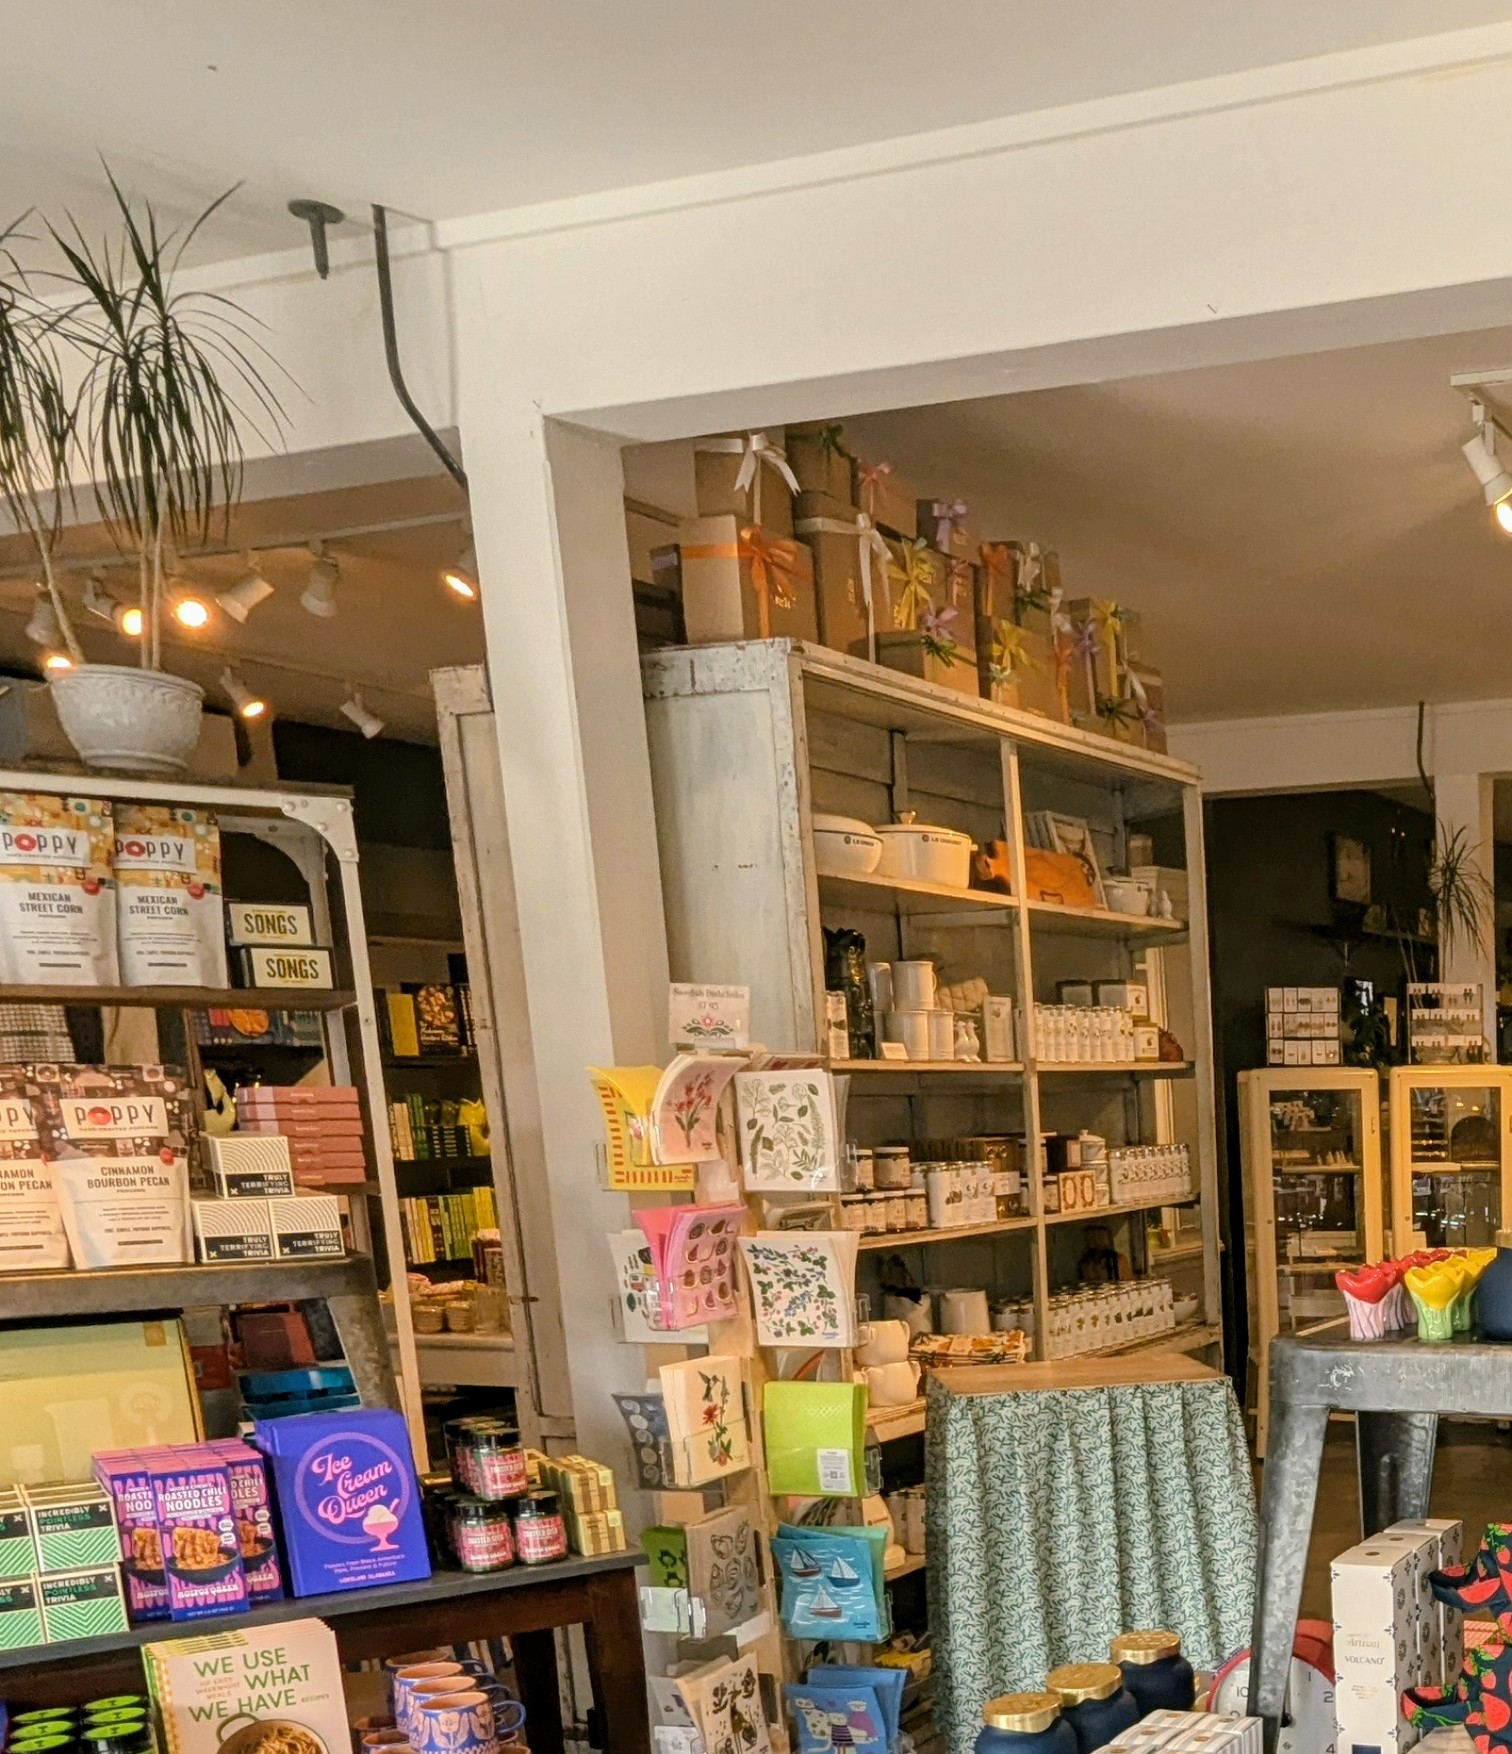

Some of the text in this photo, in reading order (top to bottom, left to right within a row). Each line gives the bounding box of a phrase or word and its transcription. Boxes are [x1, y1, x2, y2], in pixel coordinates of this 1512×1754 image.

[2, 832, 77, 854] POPPY
[115, 839, 184, 860] POPPY
[28, 892, 71, 903] MEXICAN
[137, 895, 178, 905] MEXICAN
[19, 903, 83, 914] STREET CORN
[129, 905, 188, 916] STREET CORN
[244, 913, 298, 935] SONGS
[266, 958, 319, 979] SONGS
[75, 1105, 153, 1126] POPPY
[100, 1165, 154, 1176] CINNAMON
[19, 1179, 52, 1190] PECAN
[87, 1176, 170, 1188] BOURBON PECAN
[311, 1452, 352, 1487] Ice
[337, 1460, 393, 1499] Cream
[158, 1486, 227, 1502] ROASTED CHILI
[166, 1496, 223, 1512] NOODLES
[318, 1484, 388, 1524] Queen
[38, 1506, 91, 1517] INCREDIBLY
[39, 1513, 92, 1525] POINTLESS
[40, 1522, 71, 1532] TRIVIA
[43, 1577, 96, 1590] INCREDIBLY
[44, 1584, 97, 1596] POINTLESS
[46, 1594, 76, 1603] TRIVIA
[193, 1647, 288, 1678] WE USE
[244, 1664, 310, 1691] WHAT
[1306, 1671, 1311, 1682] 1
[1323, 1691, 1334, 1703] 2
[188, 1689, 297, 1722] WE HAVE
[1325, 1743, 1336, 1754] 4
